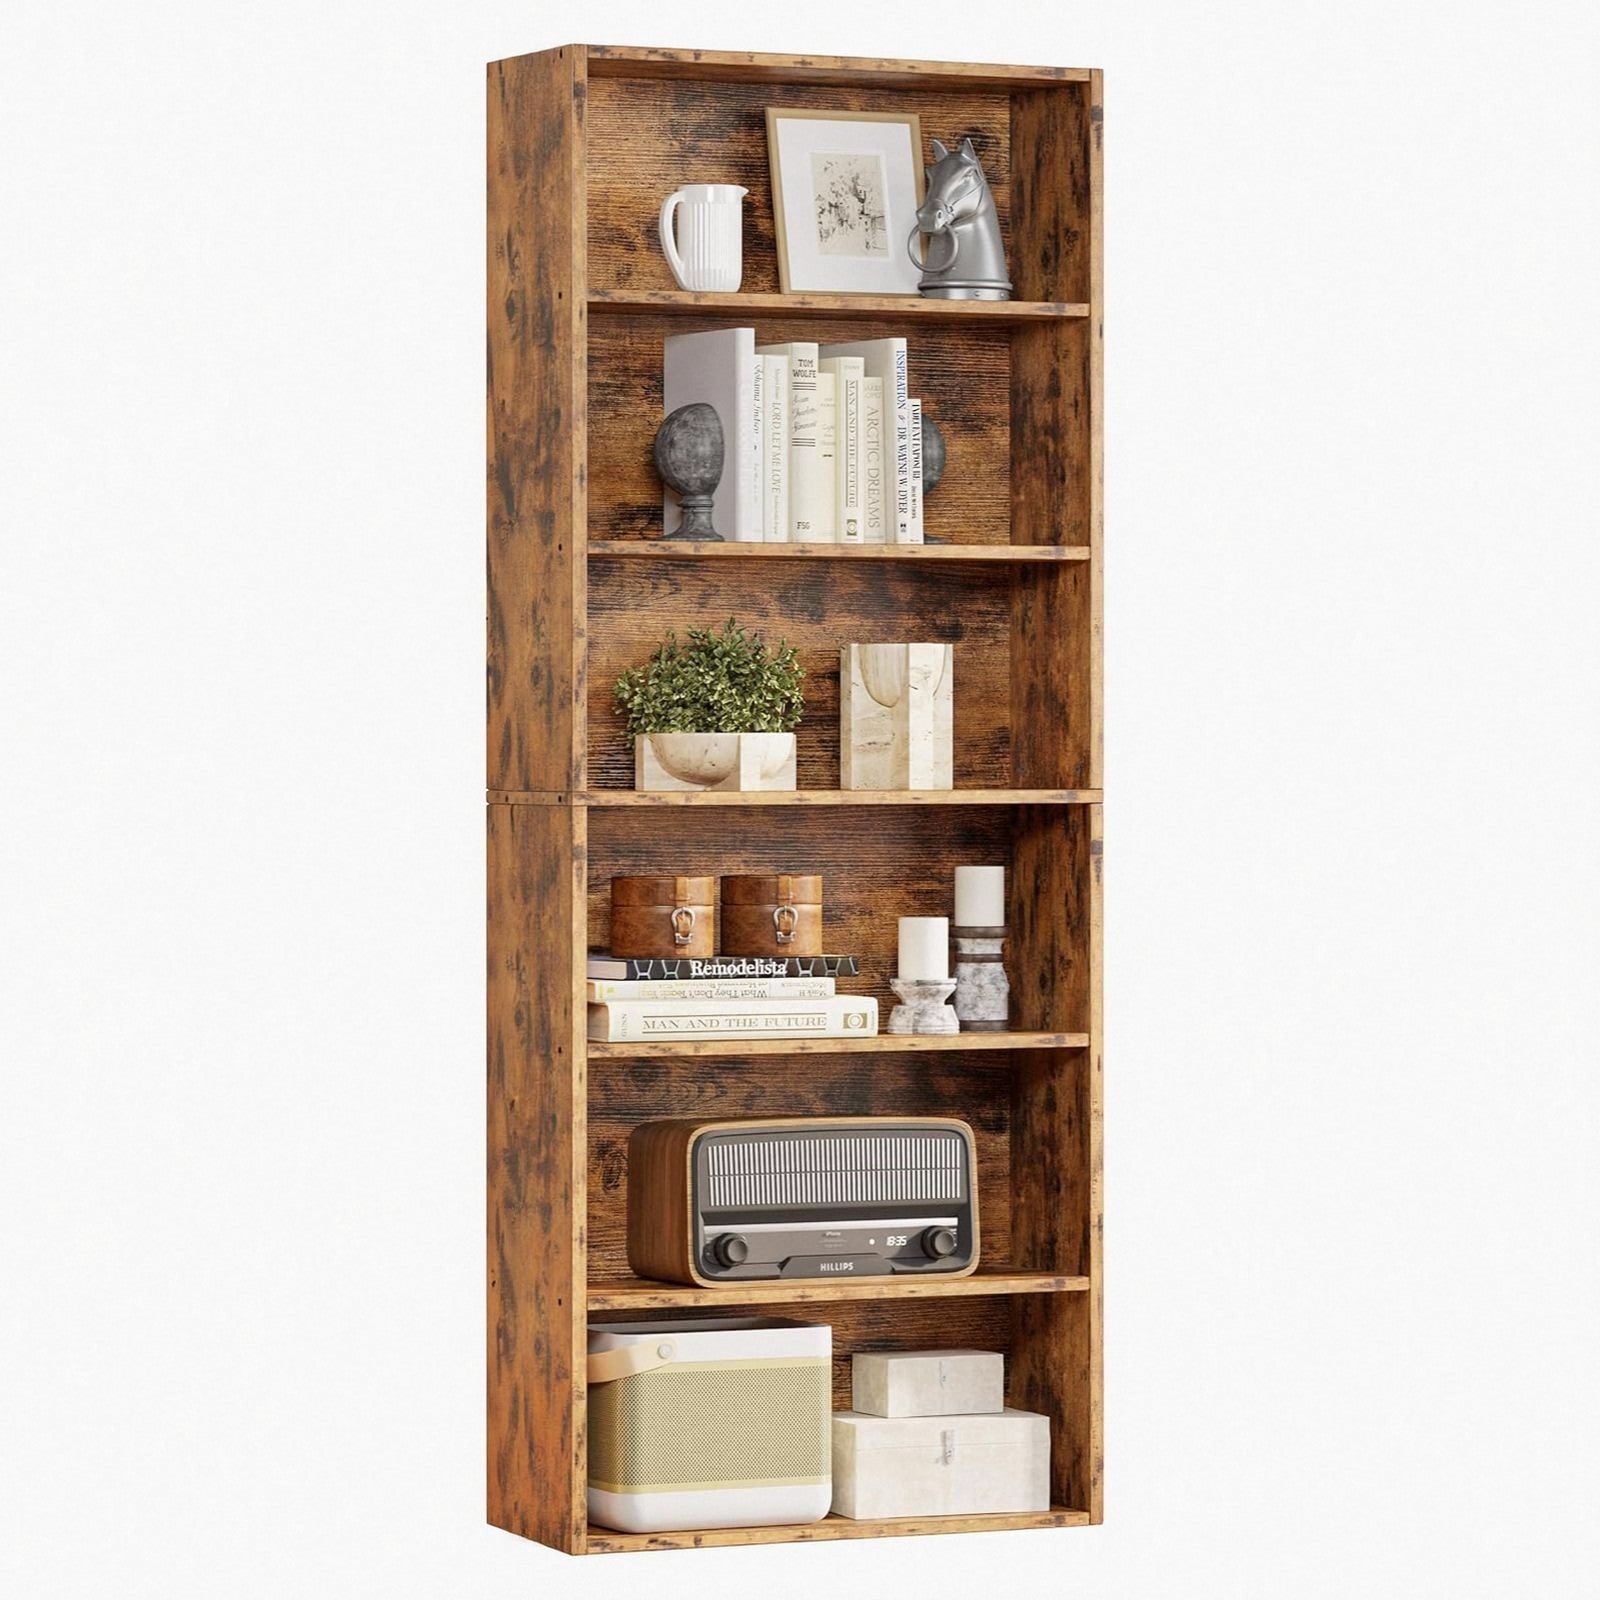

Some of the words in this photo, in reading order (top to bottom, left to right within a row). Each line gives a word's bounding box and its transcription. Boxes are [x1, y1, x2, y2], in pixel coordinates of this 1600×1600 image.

[797, 359, 814, 368] TOM
[792, 369, 817, 379] WOLFE
[896, 350, 906, 409] INSPIRATION
[772, 432, 781, 449] LET
[866, 406, 880, 463] ARCTIC
[898, 444, 907, 476] WAYNE
[772, 468, 782, 493] LOVE
[867, 467, 881, 528] DREAMS
[898, 489, 907, 514] DYER
[796, 521, 810, 530] FSG
[691, 959, 787, 976] Remodelista
[689, 989, 713, 998] Don't
[716, 987, 739, 998] They
[740, 989, 768, 998] What
[643, 1018, 680, 1030] MAN
[686, 1018, 720, 1029] AND
[725, 1018, 759, 1028] THE
[765, 1016, 827, 1028] FUTURE
[820, 1262, 854, 1271] HILLIPS
